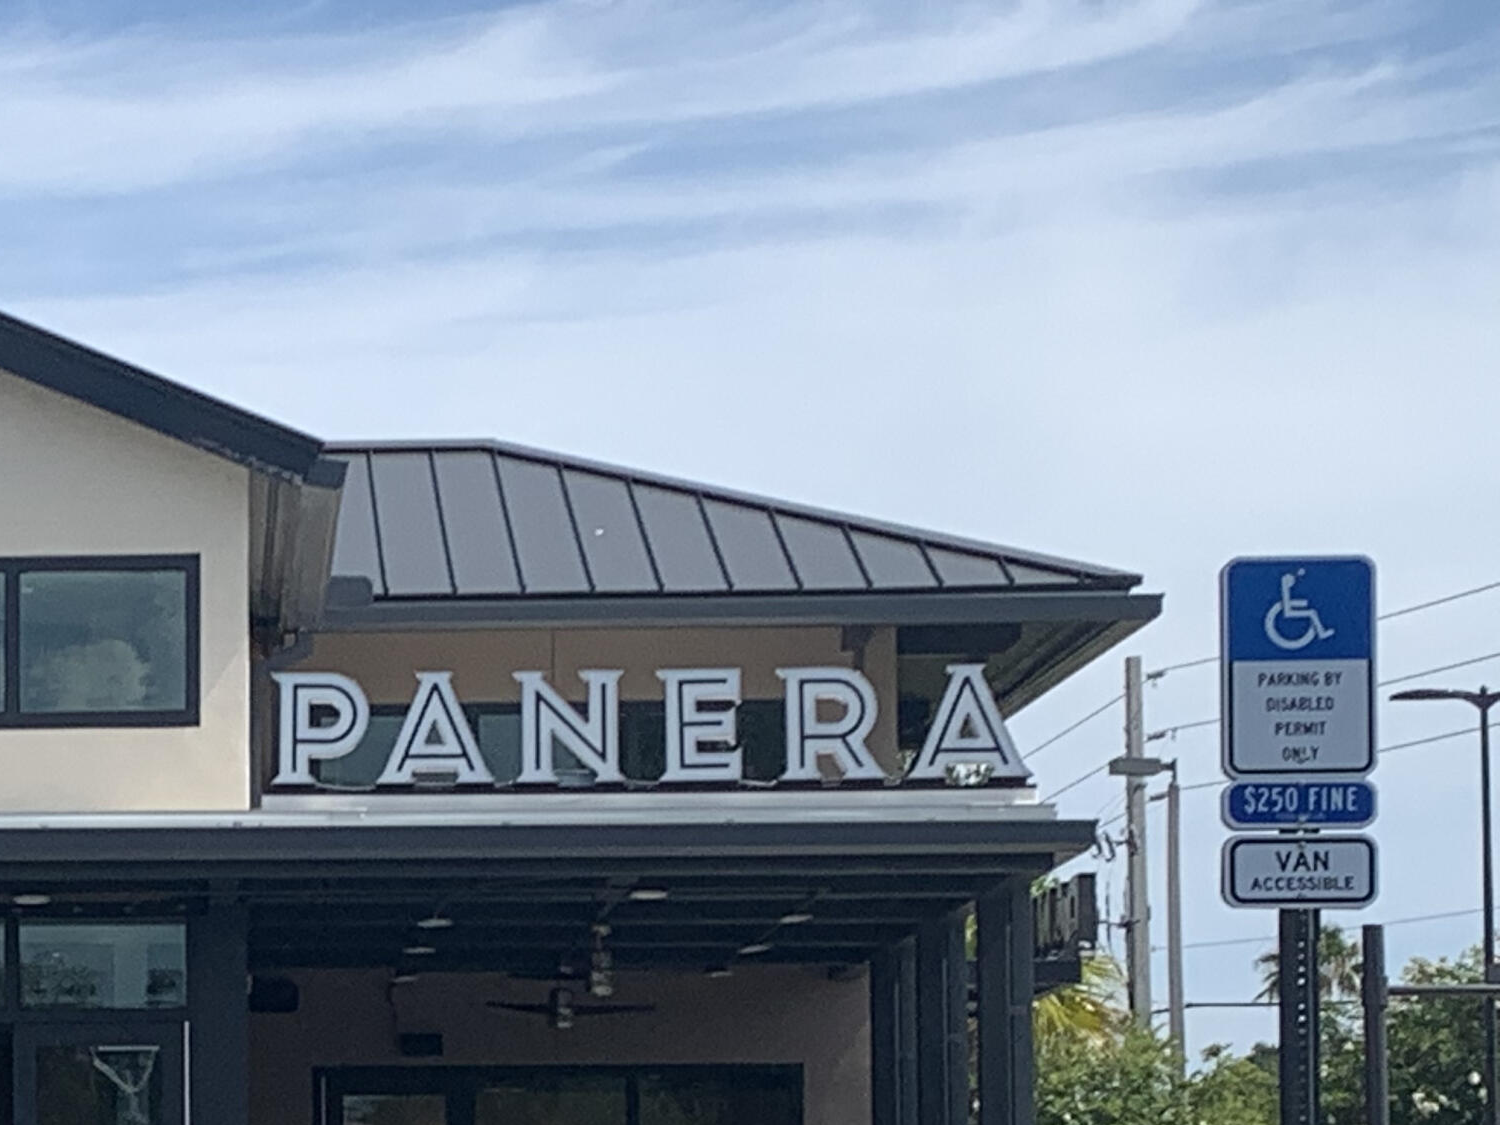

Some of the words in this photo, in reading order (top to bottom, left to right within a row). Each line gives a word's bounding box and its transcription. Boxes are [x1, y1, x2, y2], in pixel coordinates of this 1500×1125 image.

[1257, 671, 1320, 687] PARKING
[1324, 671, 1342, 686] BY
[1265, 696, 1335, 712] DISABLED
[271, 663, 1028, 785] PANERA
[1274, 721, 1328, 736] PERMIT
[1281, 746, 1320, 762] ONLY
[1243, 785, 1299, 814] $250
[1307, 785, 1359, 812] FINE
[1275, 850, 1330, 872] VAN
[1250, 875, 1355, 892] ACCESSIBLE
